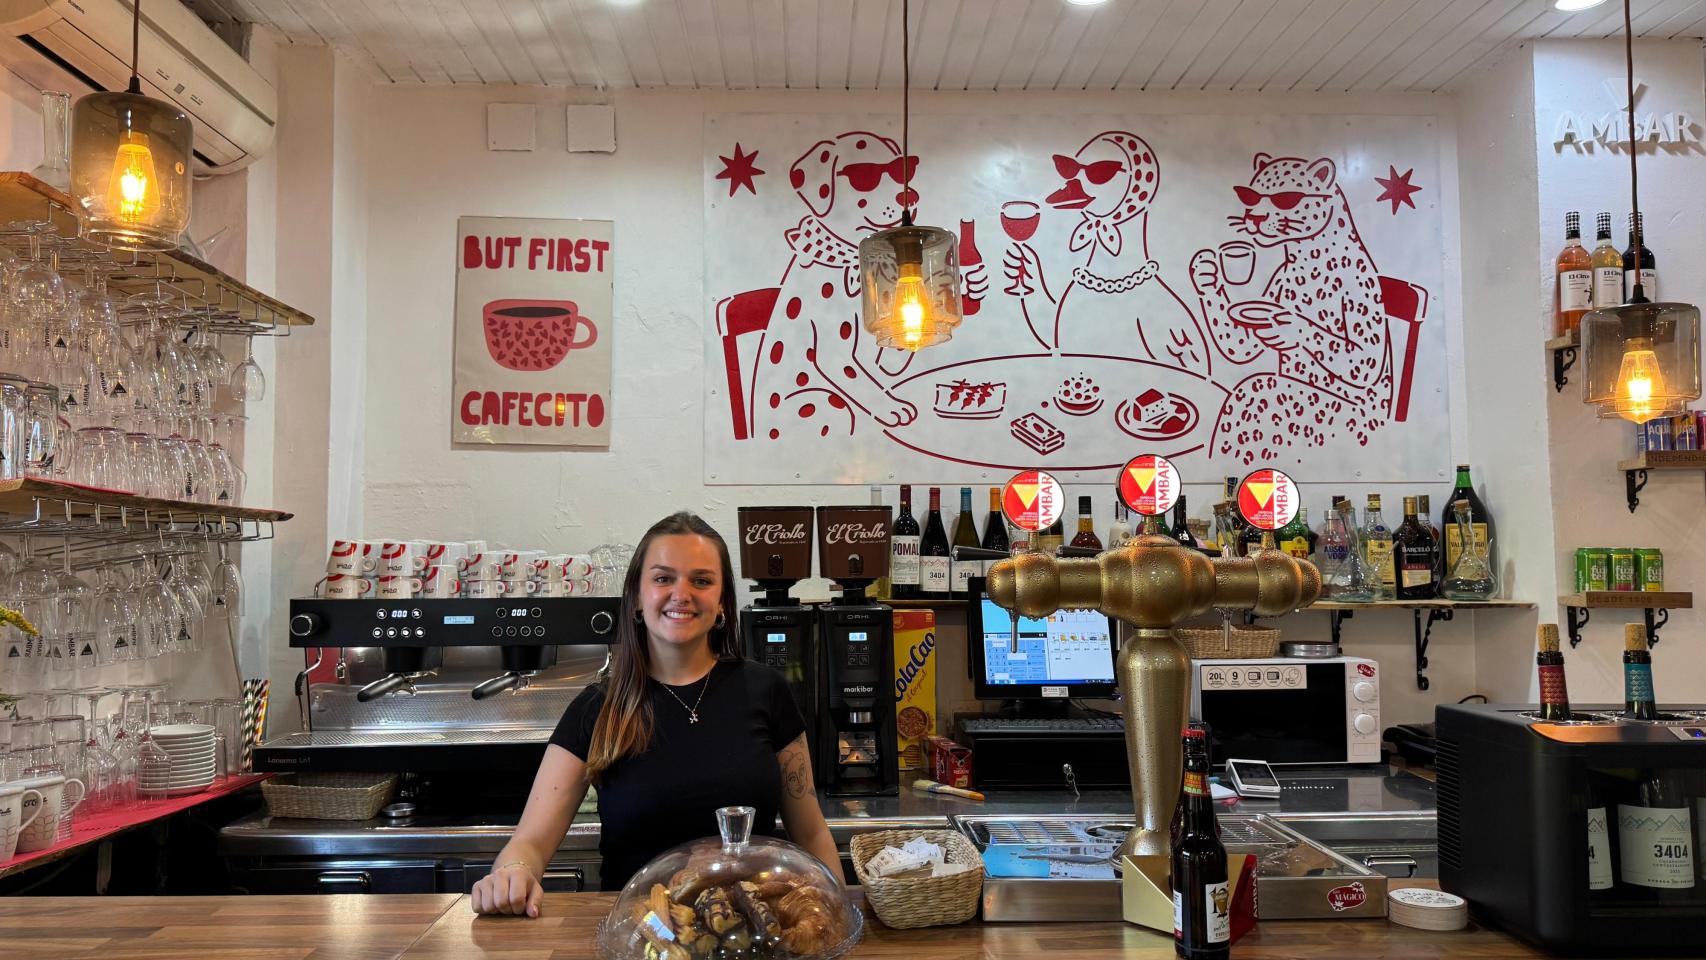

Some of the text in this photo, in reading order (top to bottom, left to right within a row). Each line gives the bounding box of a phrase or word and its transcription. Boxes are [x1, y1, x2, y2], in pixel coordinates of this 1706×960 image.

[1556, 112, 1700, 144] AMBAR
[463, 235, 610, 273] BUT FIRST
[460, 391, 605, 427] CAFECITO
[1158, 459, 1170, 512] AMBAR
[1041, 475, 1053, 526] AMBAR
[1276, 474, 1289, 526] AMBAR
[764, 522, 807, 545] Criollo
[845, 522, 887, 544] Criollo
[893, 543, 920, 556] POMAL
[930, 572, 945, 580] 3404
[1209, 672, 1225, 681] 20L
[1232, 671, 1239, 681] 9
[843, 685, 874, 694] markibar
[1653, 844, 1688, 859] 3404
[1335, 891, 1365, 901] MÁGICO
